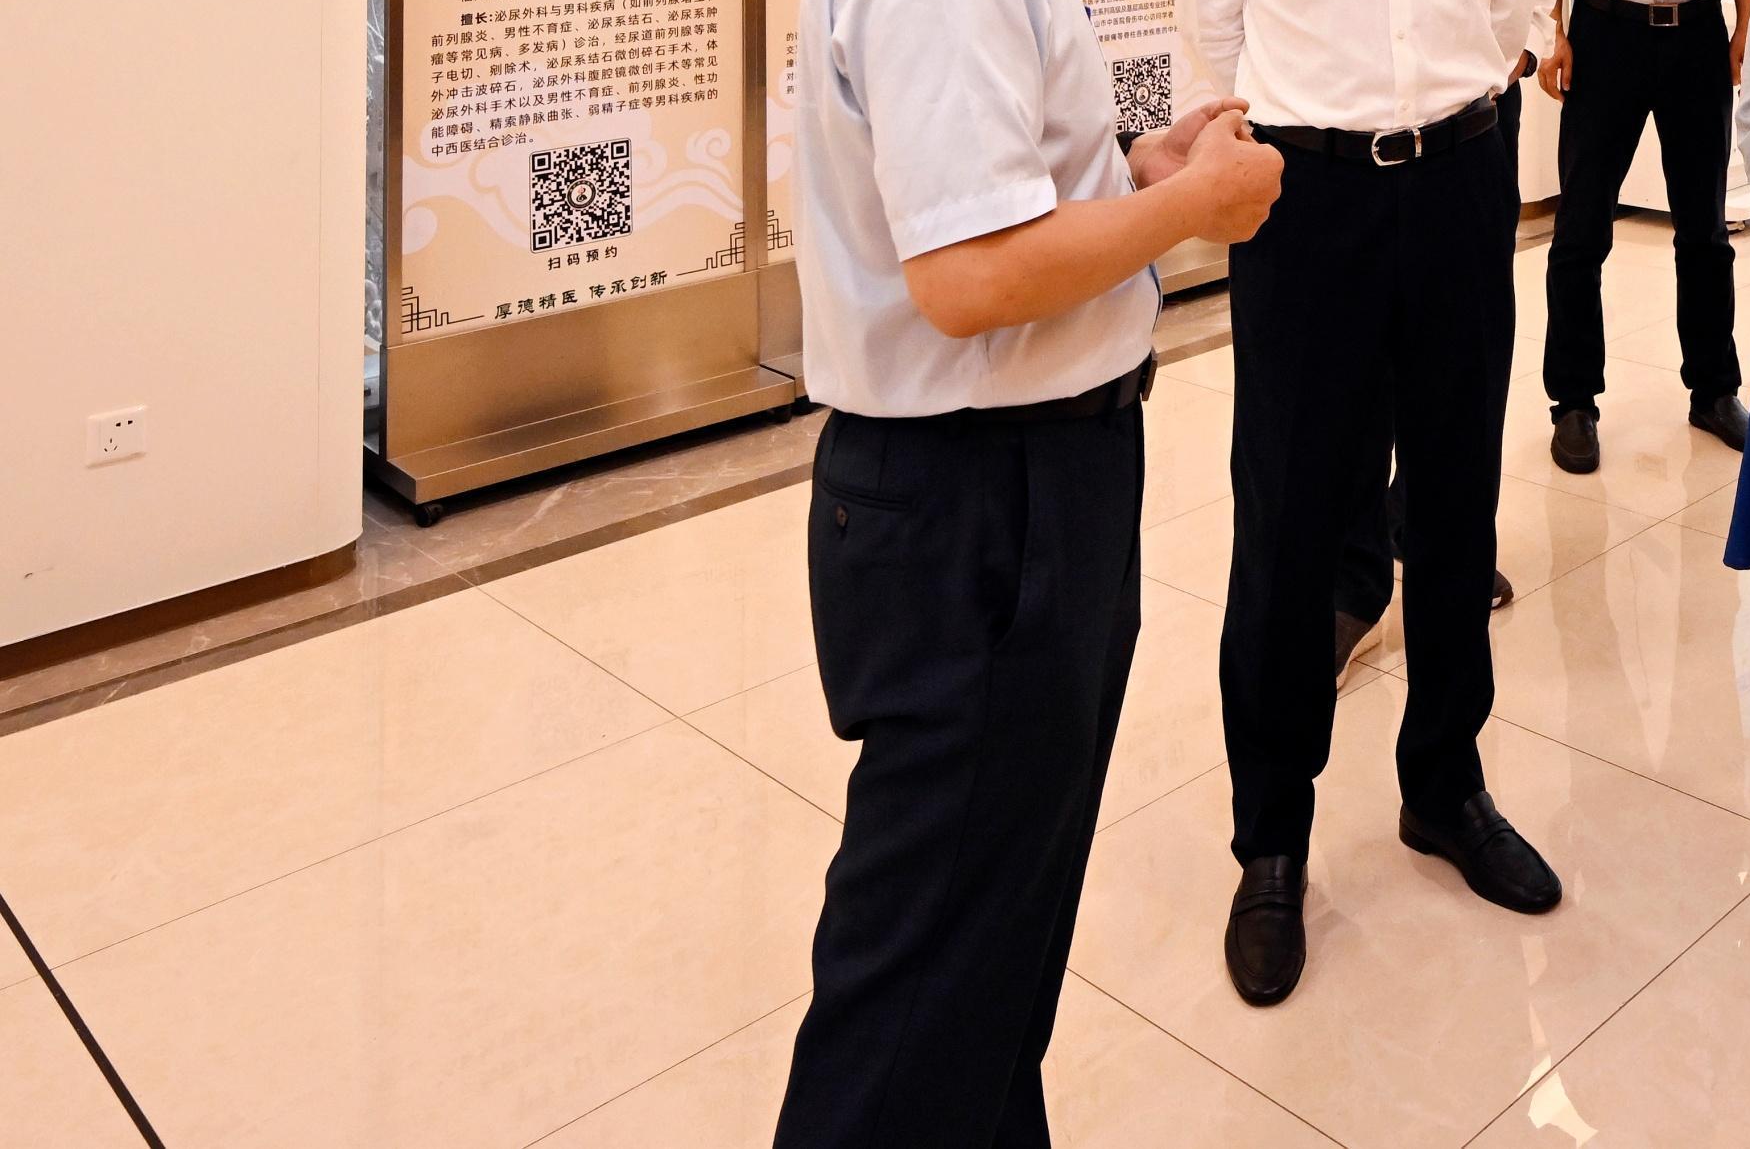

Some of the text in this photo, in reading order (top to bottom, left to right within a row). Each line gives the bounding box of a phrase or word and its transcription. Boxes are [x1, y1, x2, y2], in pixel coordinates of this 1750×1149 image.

[431, 6, 718, 48] 前列腺炎、男性不育症、泌尿系结石、泌尿系肿
[431, 72, 718, 121] 泌尿外科手术以及男性不育症、前列腺炎、性功
[431, 89, 718, 139] 能障碍、精索静脉曲张、弱精子症等男科疾病的
[431, 132, 535, 158] 中西医结合诊治。
[547, 246, 618, 271] 扫码预约
[494, 270, 668, 320] 厚德精医 传承创新
